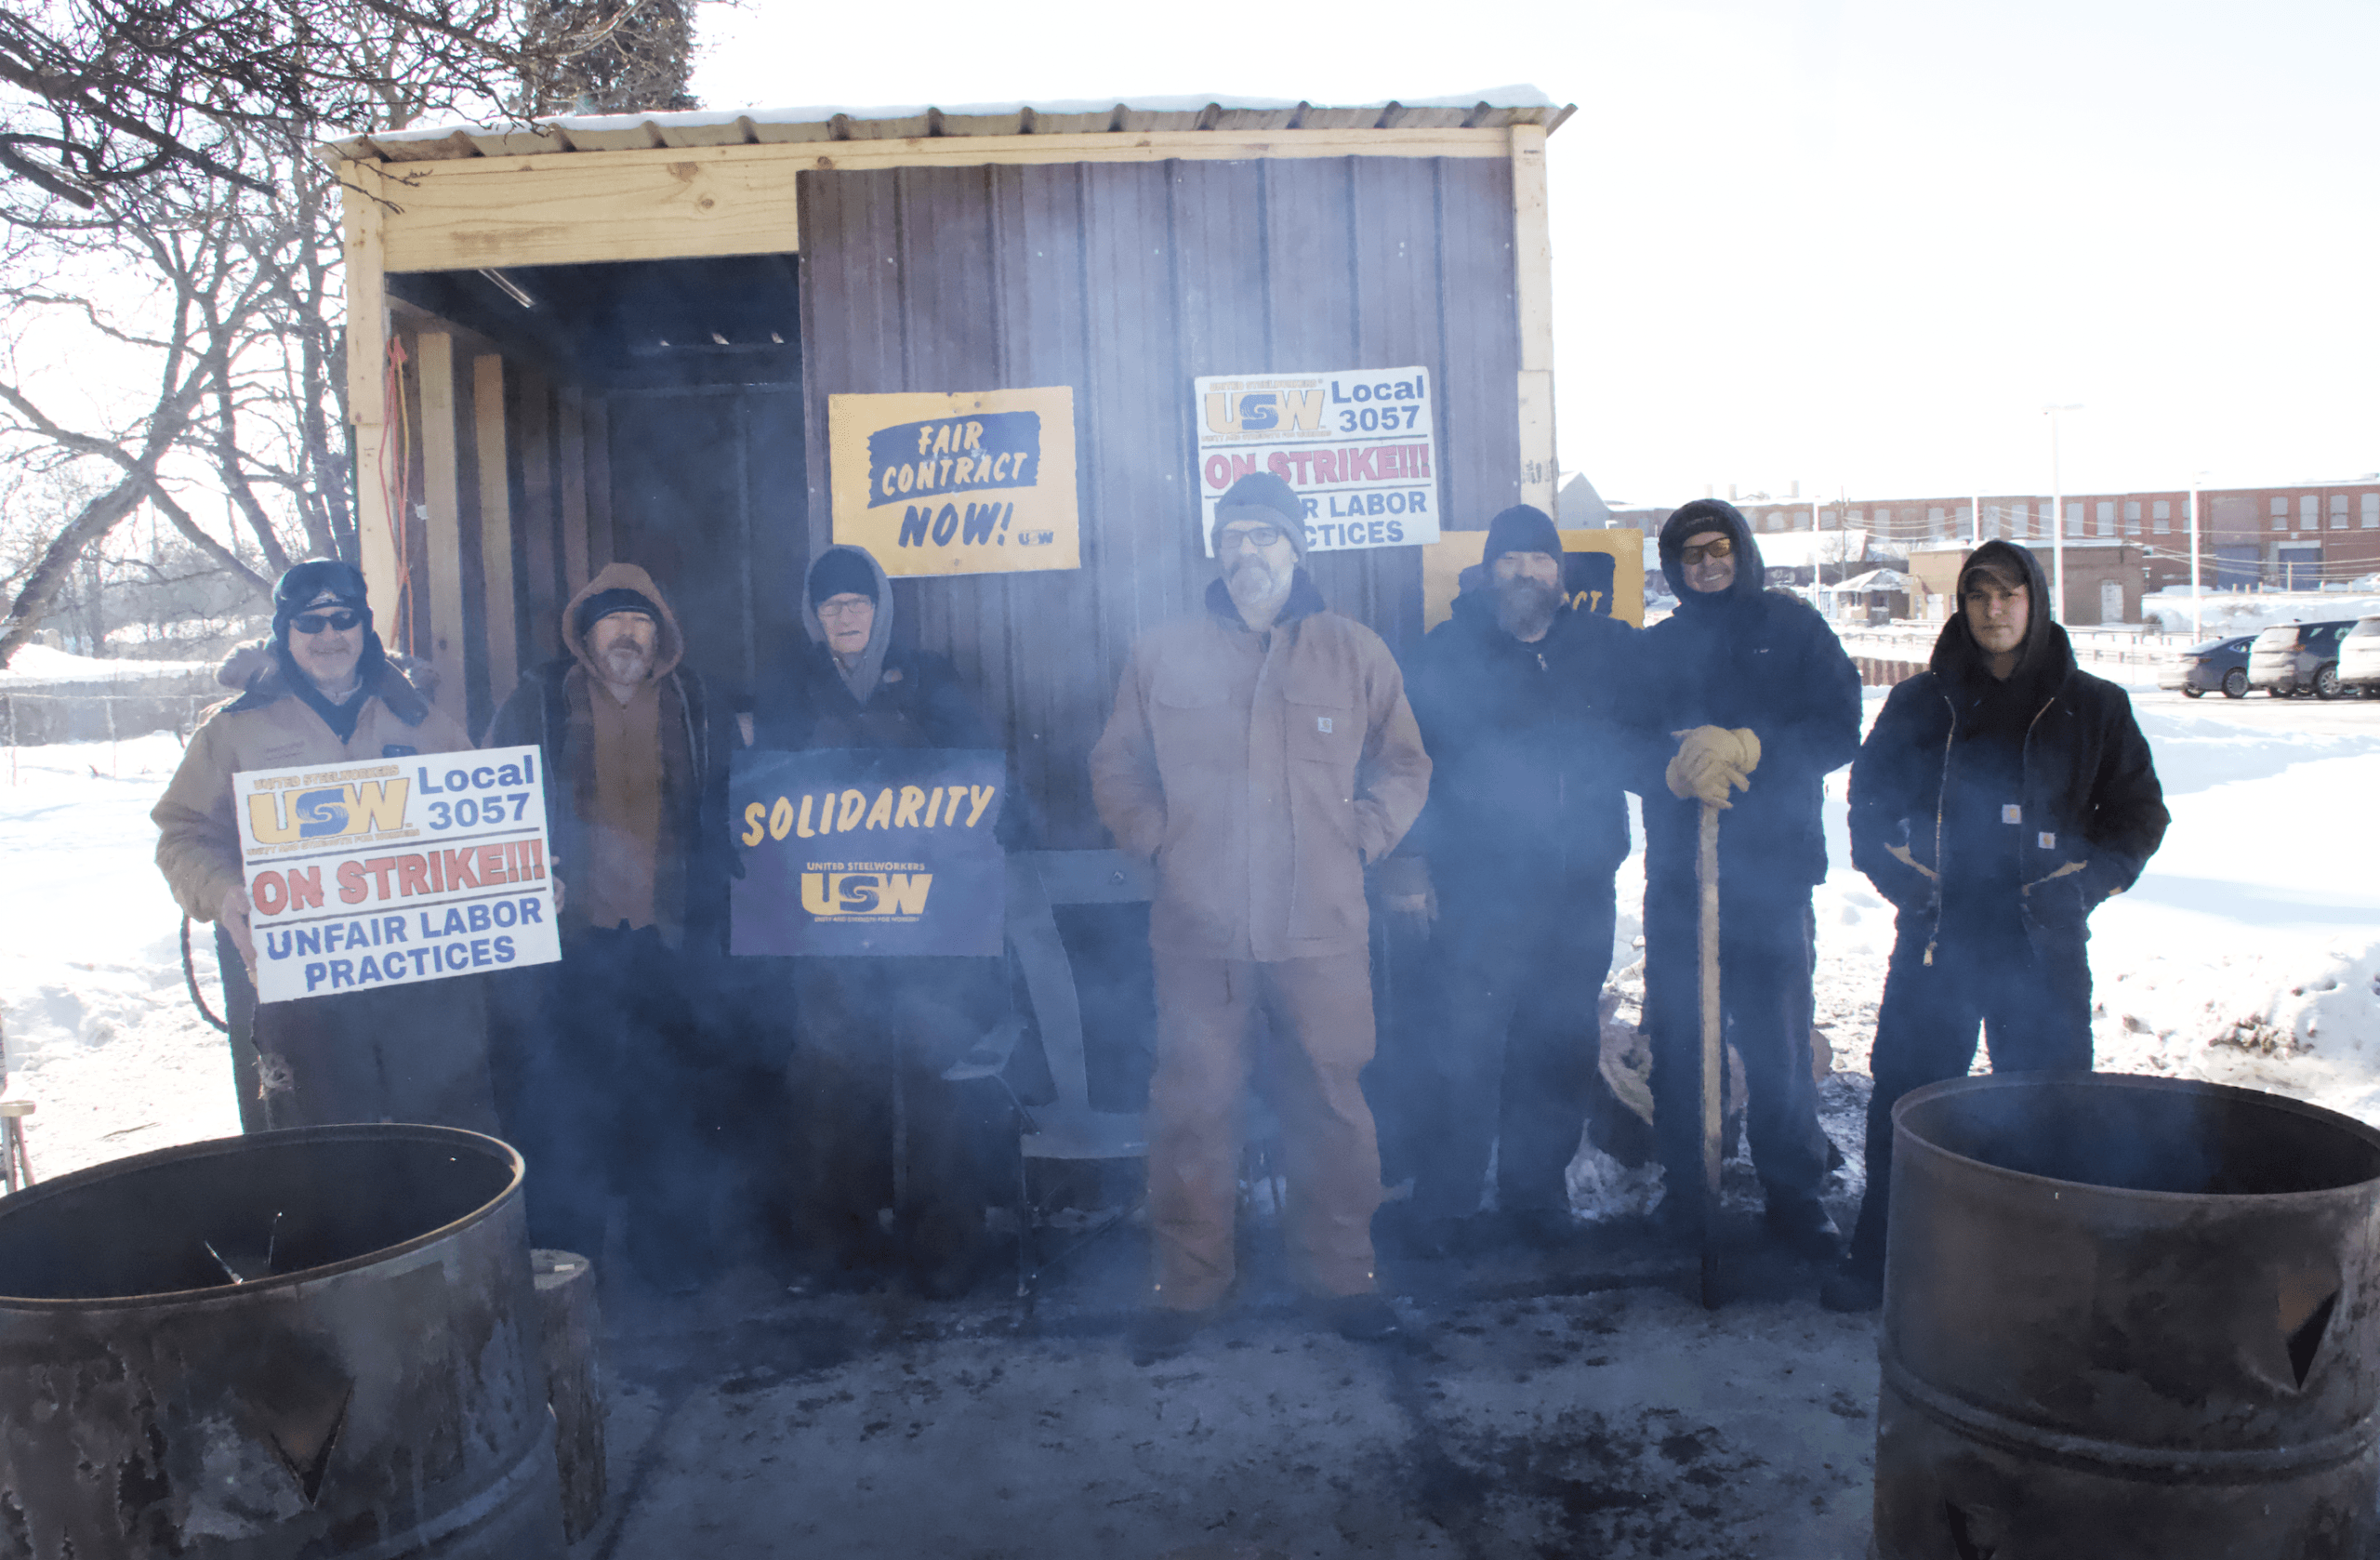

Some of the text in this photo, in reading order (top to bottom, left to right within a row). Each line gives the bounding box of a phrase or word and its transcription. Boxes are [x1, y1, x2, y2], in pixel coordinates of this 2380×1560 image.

[1331, 375, 1424, 403] Local
[1205, 390, 1325, 434] USW
[1339, 404, 1420, 432] 3057
[918, 421, 984, 456] FAIR
[882, 452, 1028, 496] CONTRACT
[1205, 443, 1431, 490] ON STRIKE!!!
[898, 501, 1014, 549] NOW!
[1329, 491, 1427, 518] LABOR
[1304, 520, 1404, 548] CTICES
[418, 754, 535, 795] Local
[247, 777, 411, 845] USW
[428, 792, 530, 831] 3057
[742, 785, 995, 847] SOLIDARITY
[252, 838, 546, 916] ON STRIKE!!!
[806, 862, 925, 871] UNITED STEELWORKERS
[801, 872, 933, 916] USW
[267, 897, 543, 960] UNFAIR LABOR
[305, 935, 516, 993] PRACTICES
